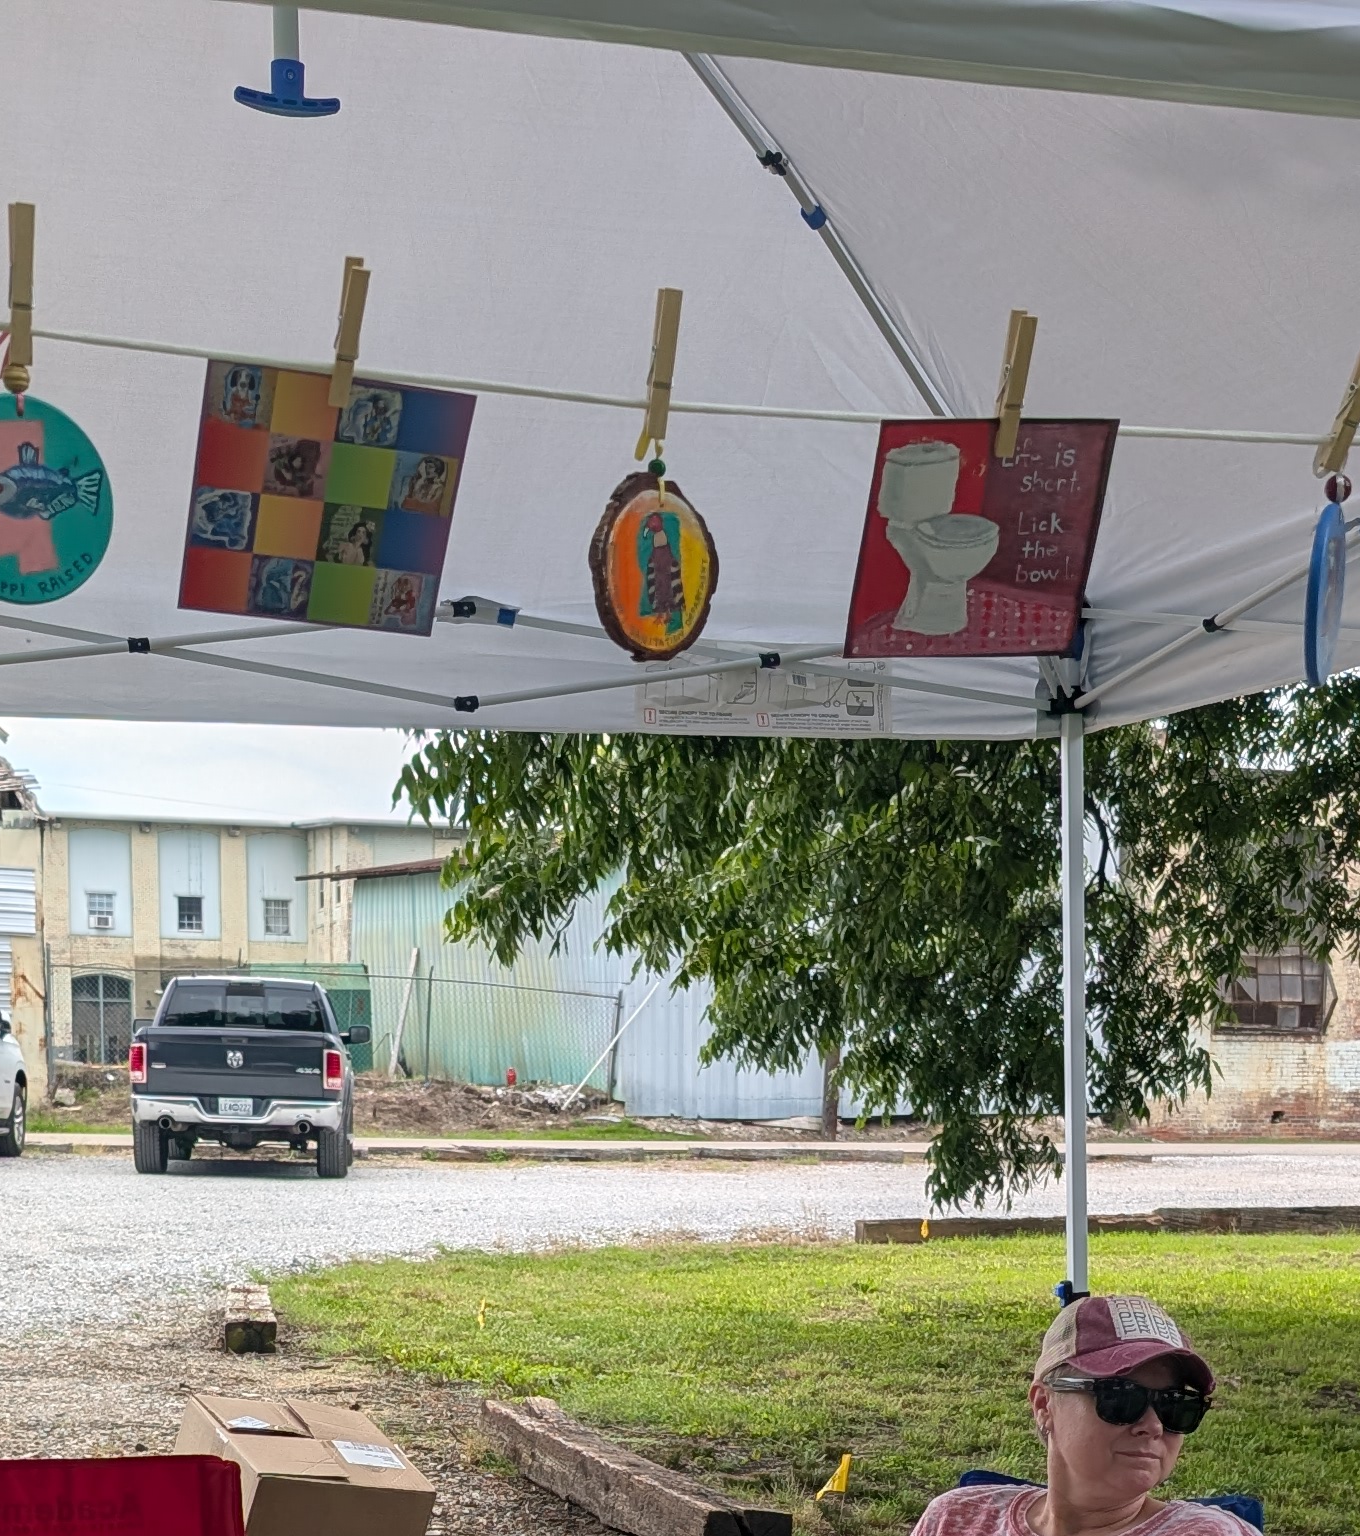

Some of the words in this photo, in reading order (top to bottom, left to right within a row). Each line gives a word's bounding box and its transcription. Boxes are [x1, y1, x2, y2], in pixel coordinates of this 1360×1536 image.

[1055, 442, 1075, 467] is
[1018, 511, 1063, 535] Lick
[1022, 540, 1058, 559] the
[38, 553, 93, 596] RAISED
